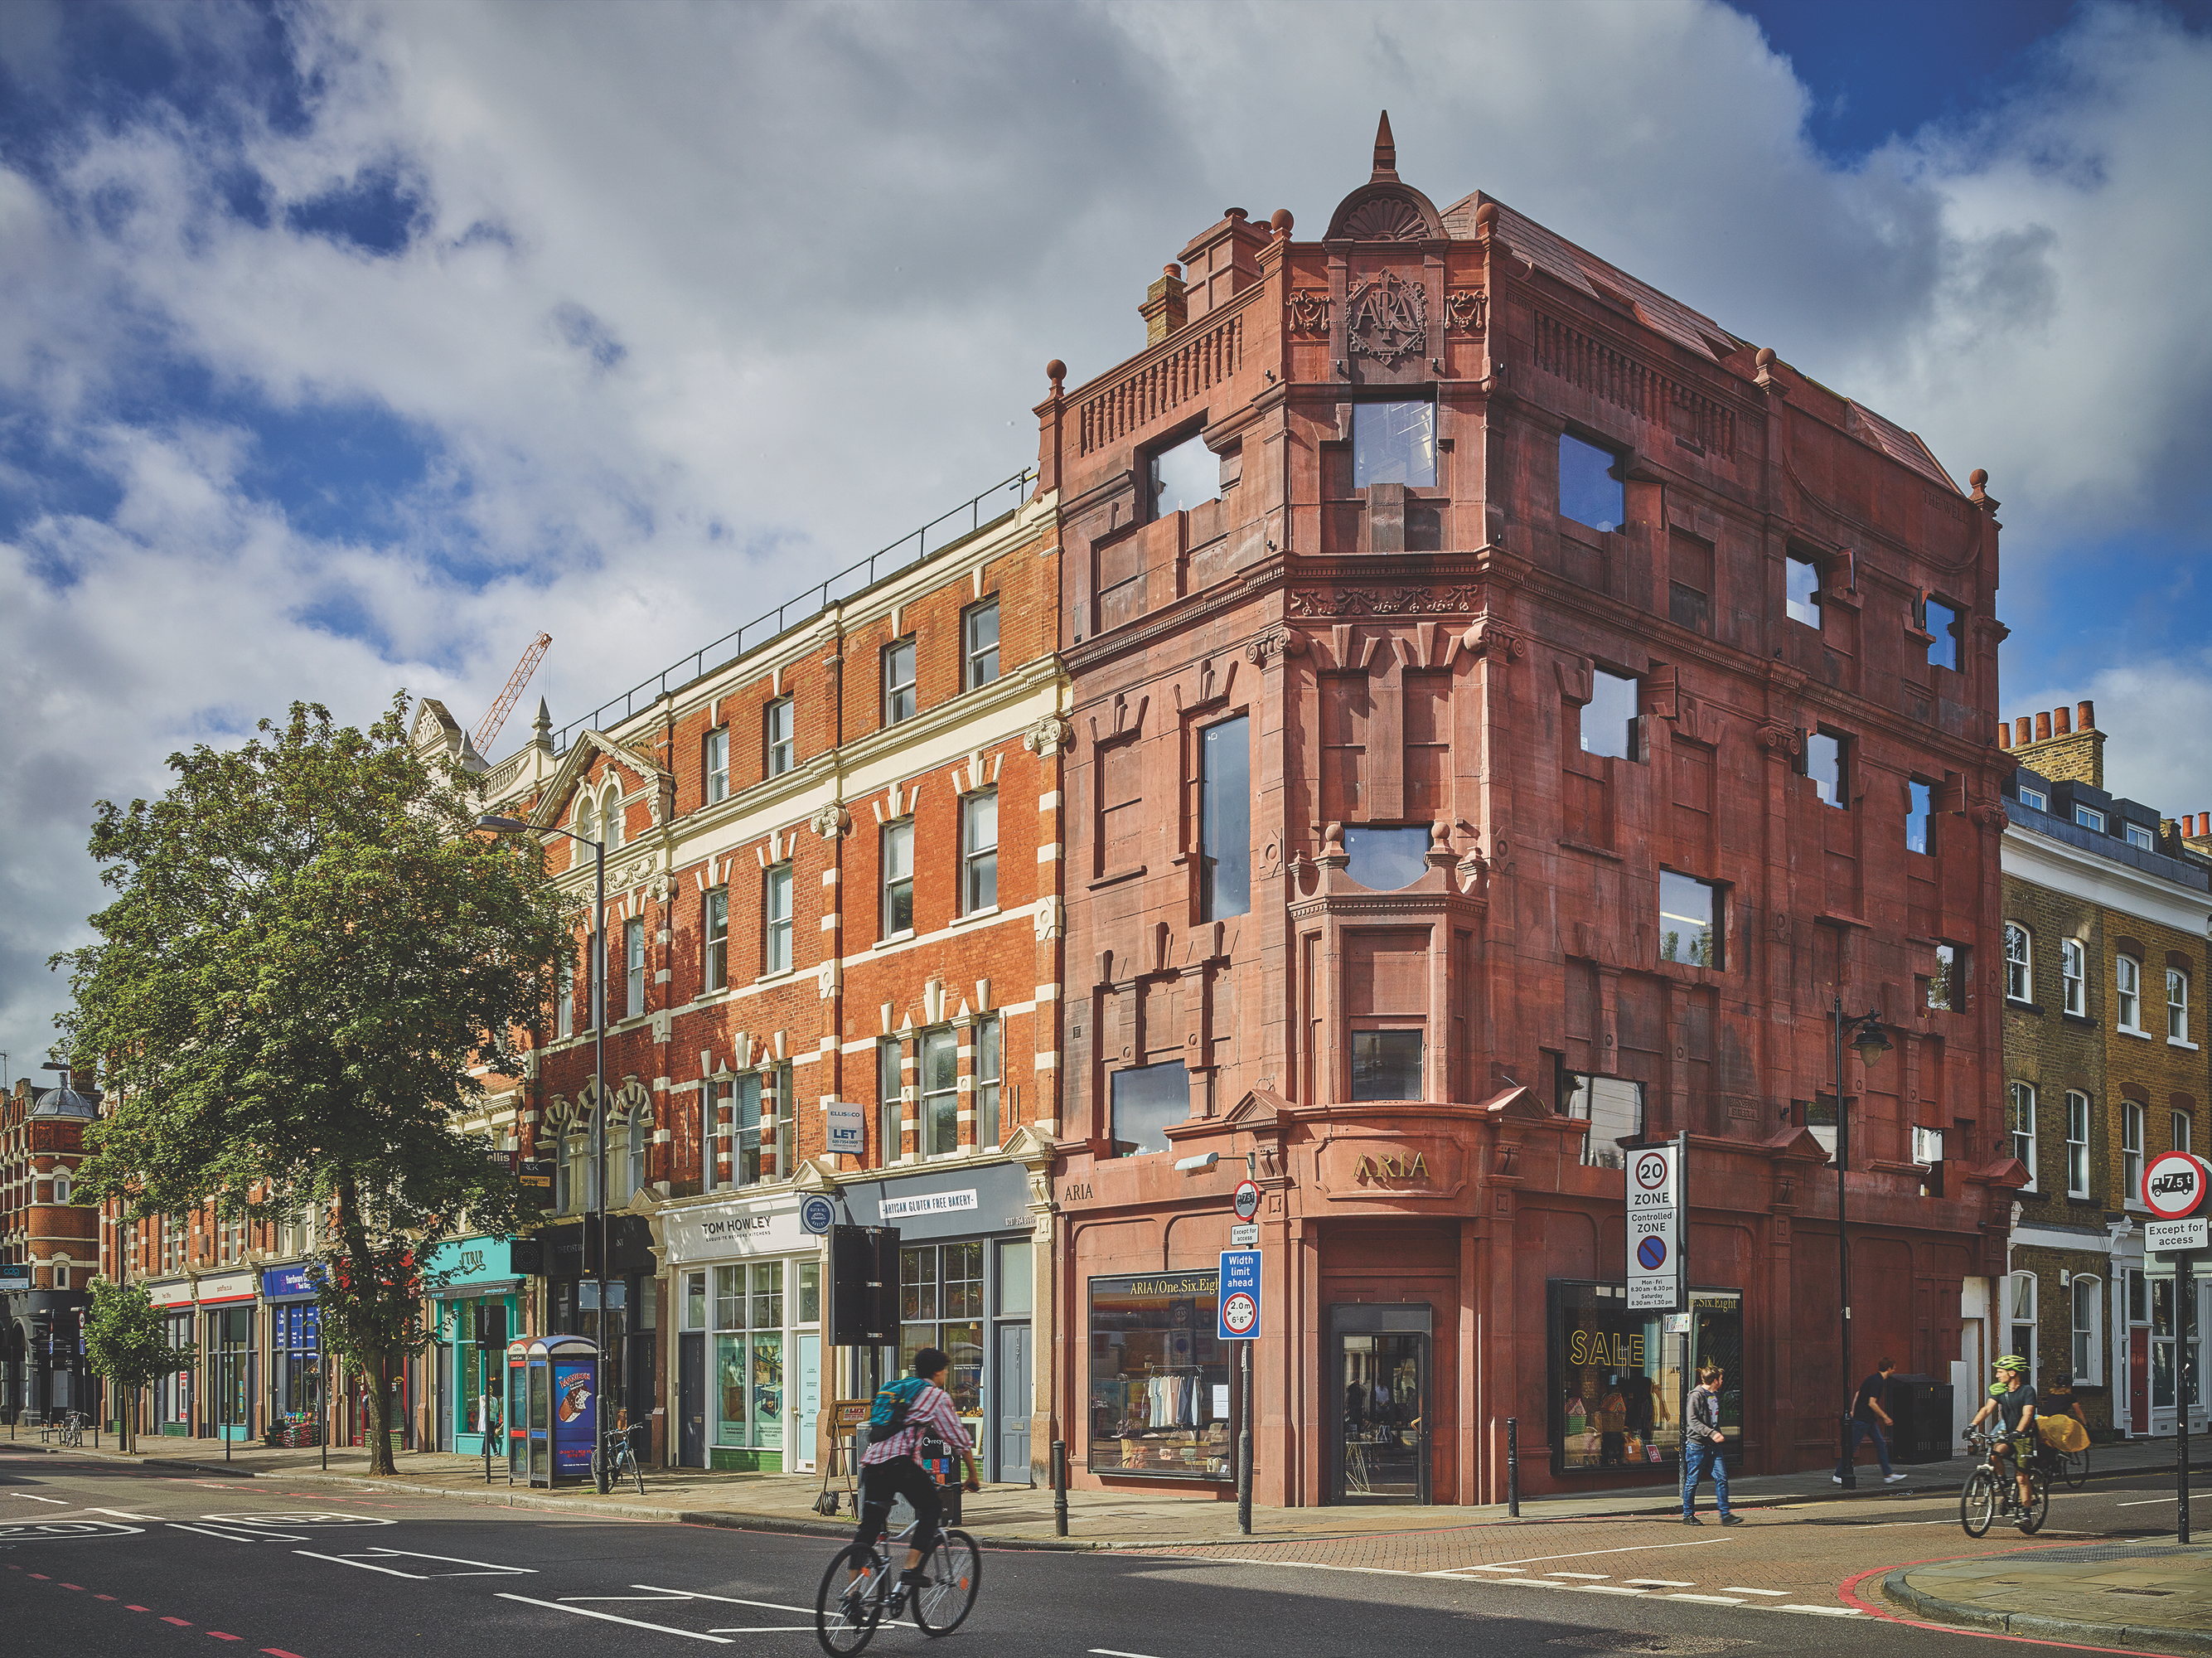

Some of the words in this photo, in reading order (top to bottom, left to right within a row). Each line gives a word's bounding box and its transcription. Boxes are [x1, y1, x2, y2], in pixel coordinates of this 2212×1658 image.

[833, 1128, 857, 1139] LET
[486, 1152, 511, 1162] ellis
[1350, 1151, 1431, 1177] ARIA
[1640, 1163, 1663, 1180] 20
[1064, 1183, 1094, 1202] ARIA
[1634, 1192, 1669, 1205] ZONE
[908, 1199, 931, 1212] GLUTEN
[932, 1197, 946, 1209] FREE
[1631, 1211, 1672, 1222] Controlled
[701, 1221, 724, 1234] TOM
[726, 1215, 772, 1231] HOWLEY
[1637, 1222, 1666, 1234] ZONE
[2148, 1225, 2185, 1237] Except
[2187, 1223, 2204, 1233] for
[705, 1234, 728, 1243] EXQUISITE
[2158, 1236, 2194, 1246] access
[459, 1250, 486, 1272] STRIP
[1228, 1256, 1253, 1265] Width
[3, 1267, 20, 1277] cdg
[1231, 1267, 1251, 1276] limit
[285, 1274, 303, 1284] Hardware
[1227, 1277, 1253, 1287] ahead
[1130, 1277, 1220, 1295] ARIA/One.Six.Eigh
[1570, 1330, 1644, 1367] SALE
[559, 1373, 591, 1390] MAXIBON
